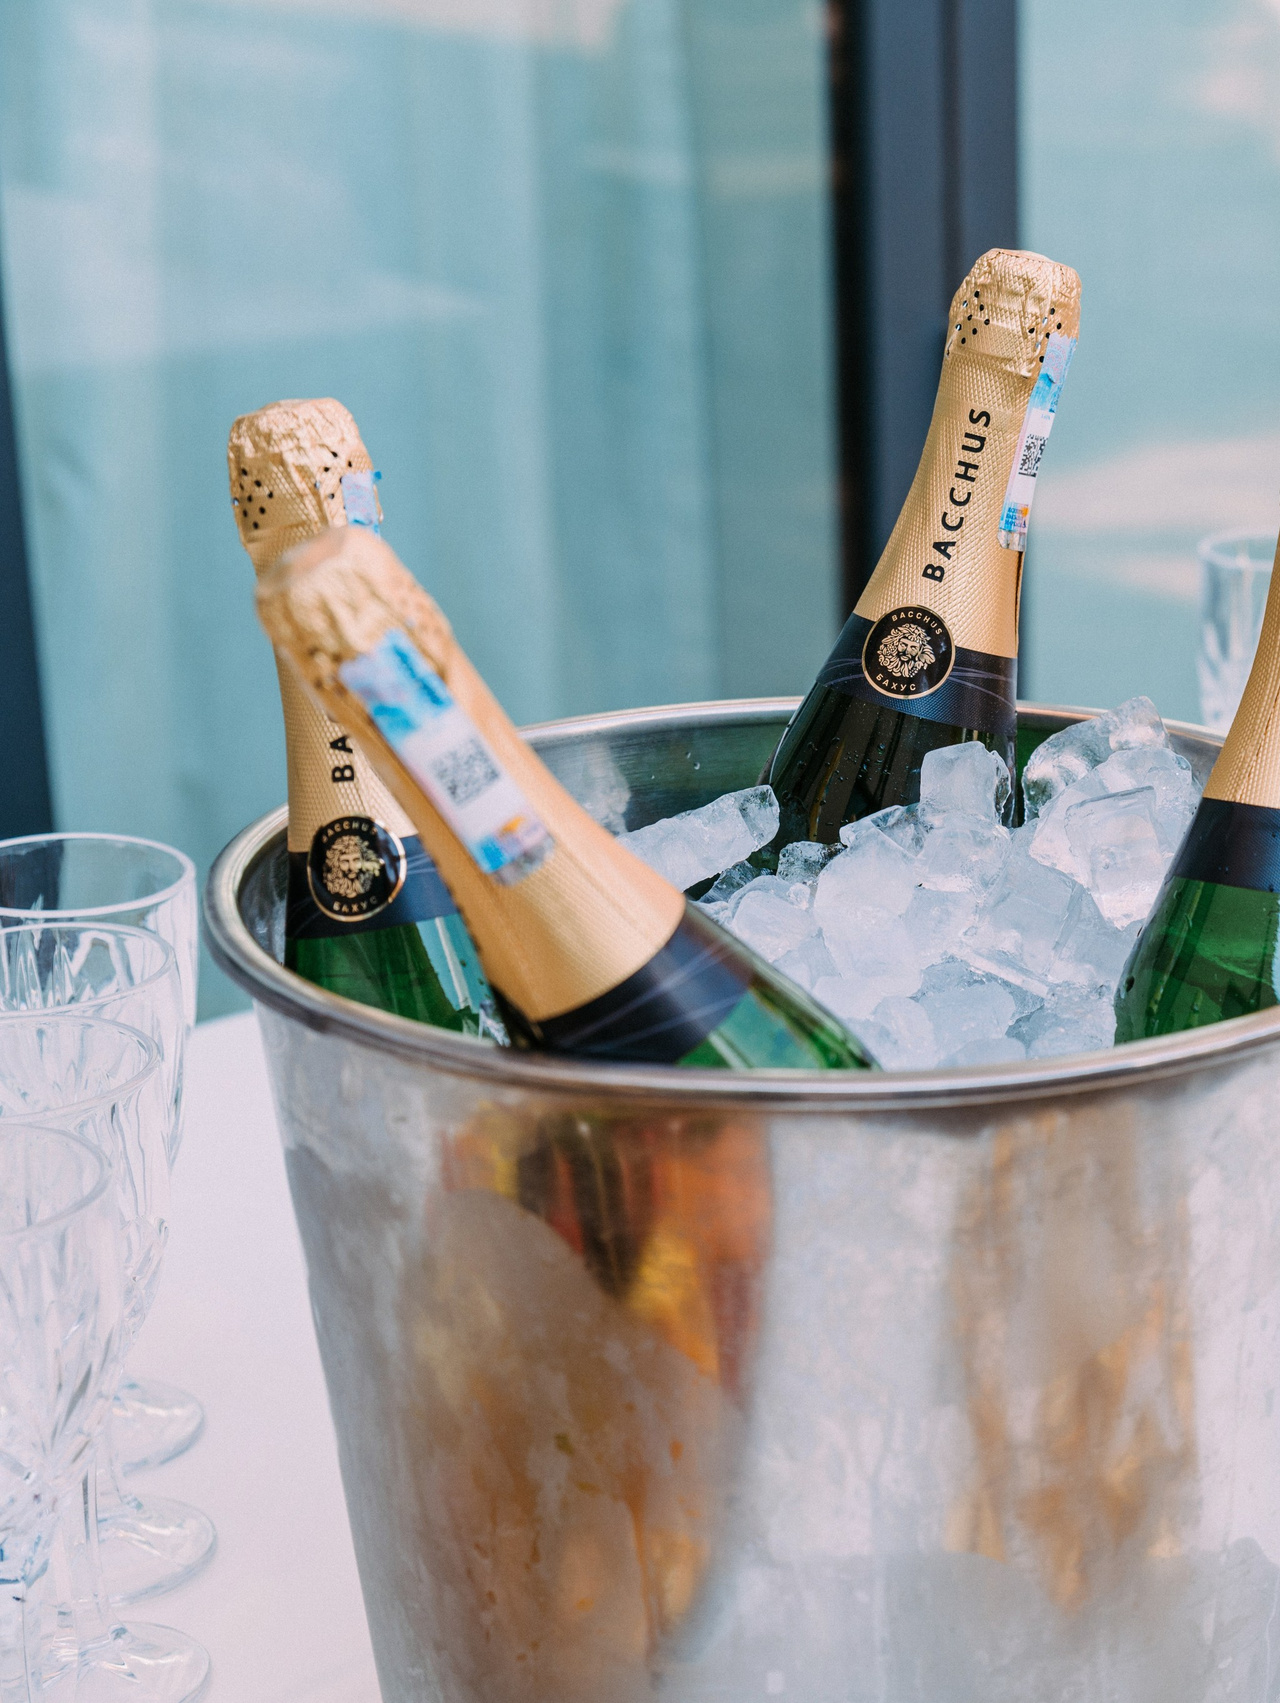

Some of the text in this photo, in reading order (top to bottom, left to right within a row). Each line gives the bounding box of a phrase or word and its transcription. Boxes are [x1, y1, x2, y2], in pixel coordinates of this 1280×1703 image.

[922, 409, 991, 583] BACCHUS
[892, 611, 943, 636] BACCHUS
[876, 673, 916, 692] БАХУС
[330, 714, 355, 783] BA
